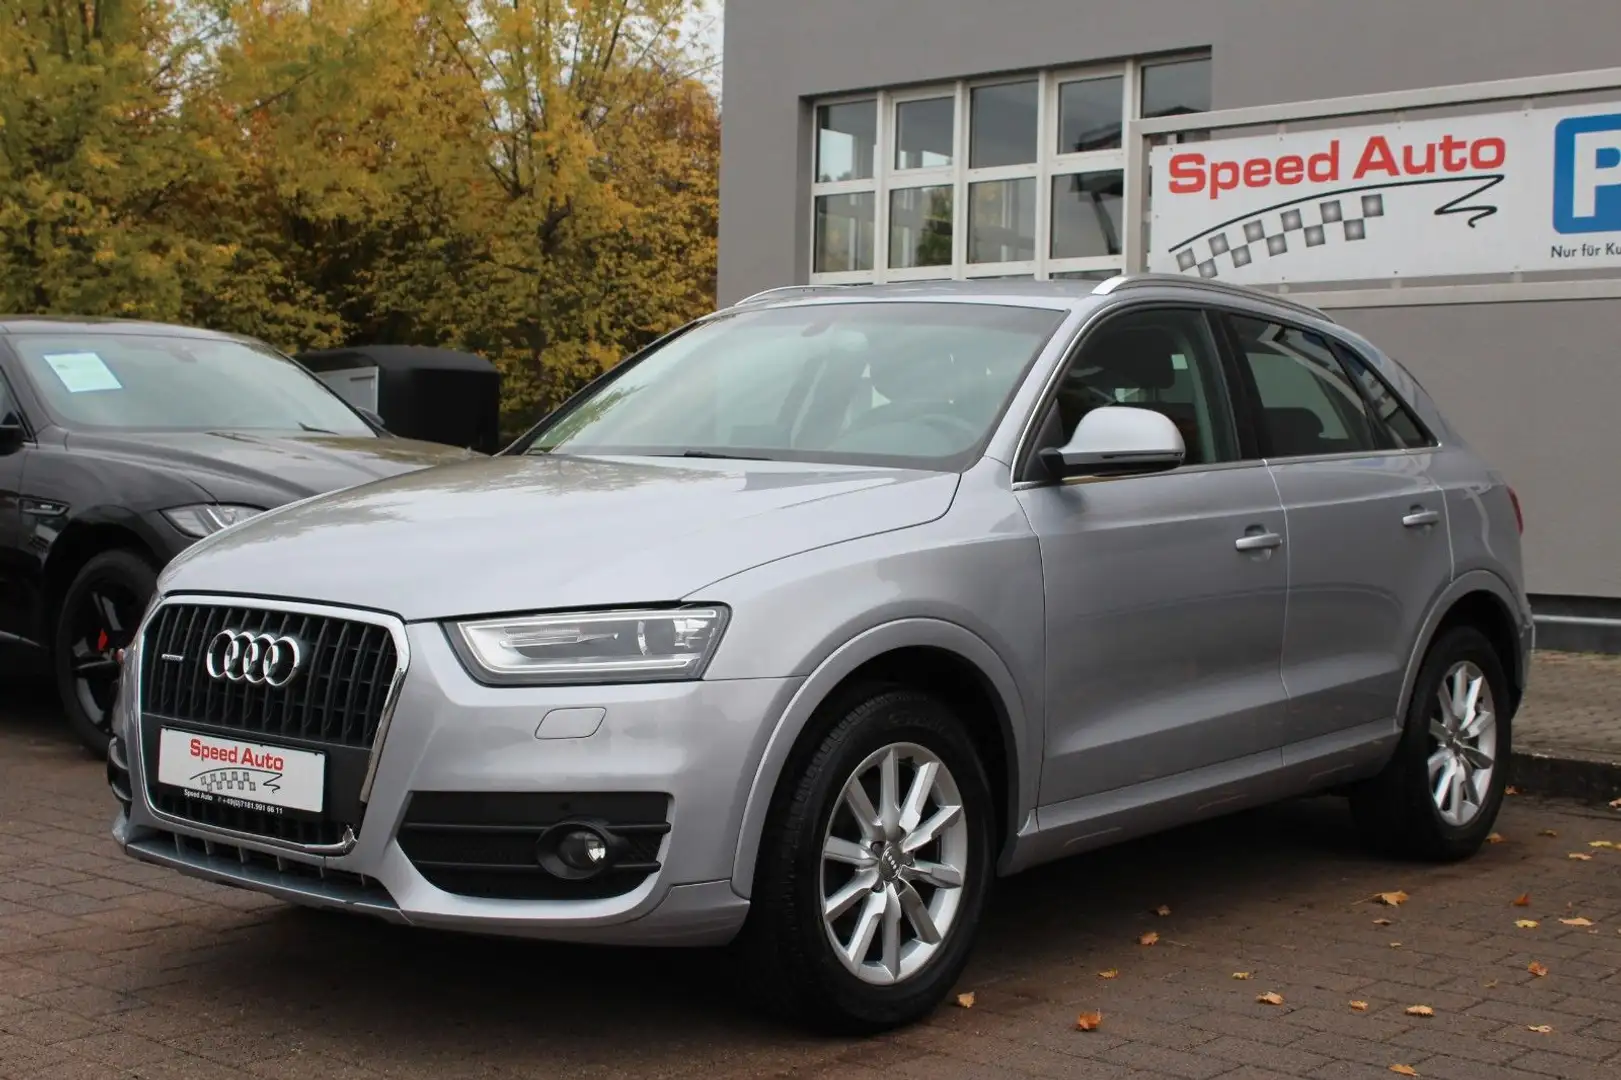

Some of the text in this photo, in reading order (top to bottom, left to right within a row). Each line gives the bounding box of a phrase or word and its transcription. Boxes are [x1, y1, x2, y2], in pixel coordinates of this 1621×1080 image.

[1168, 134, 1506, 200] Speed Auto
[1550, 244, 1577, 258] Nur
[1581, 243, 1601, 257] für
[189, 738, 284, 771] Speed Auto
[184, 788, 200, 799] Speed
[200, 791, 213, 801] Auto
